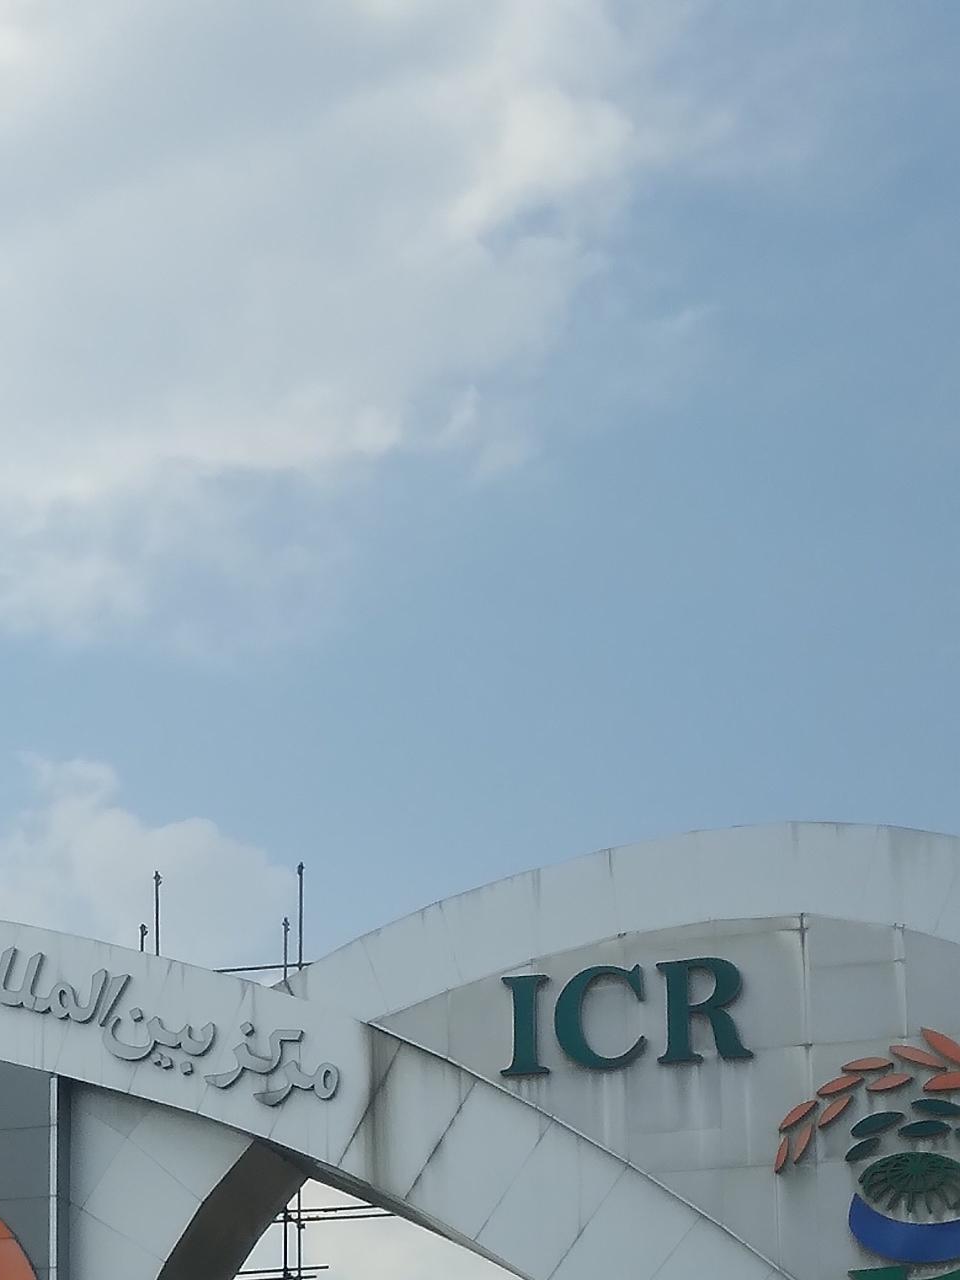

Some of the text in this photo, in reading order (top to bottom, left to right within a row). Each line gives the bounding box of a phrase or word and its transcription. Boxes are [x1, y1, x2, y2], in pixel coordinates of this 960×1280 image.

[102, 1006, 216, 1076] بین
[500, 956, 755, 1079] ICR
[203, 1020, 340, 1107] مرکز
